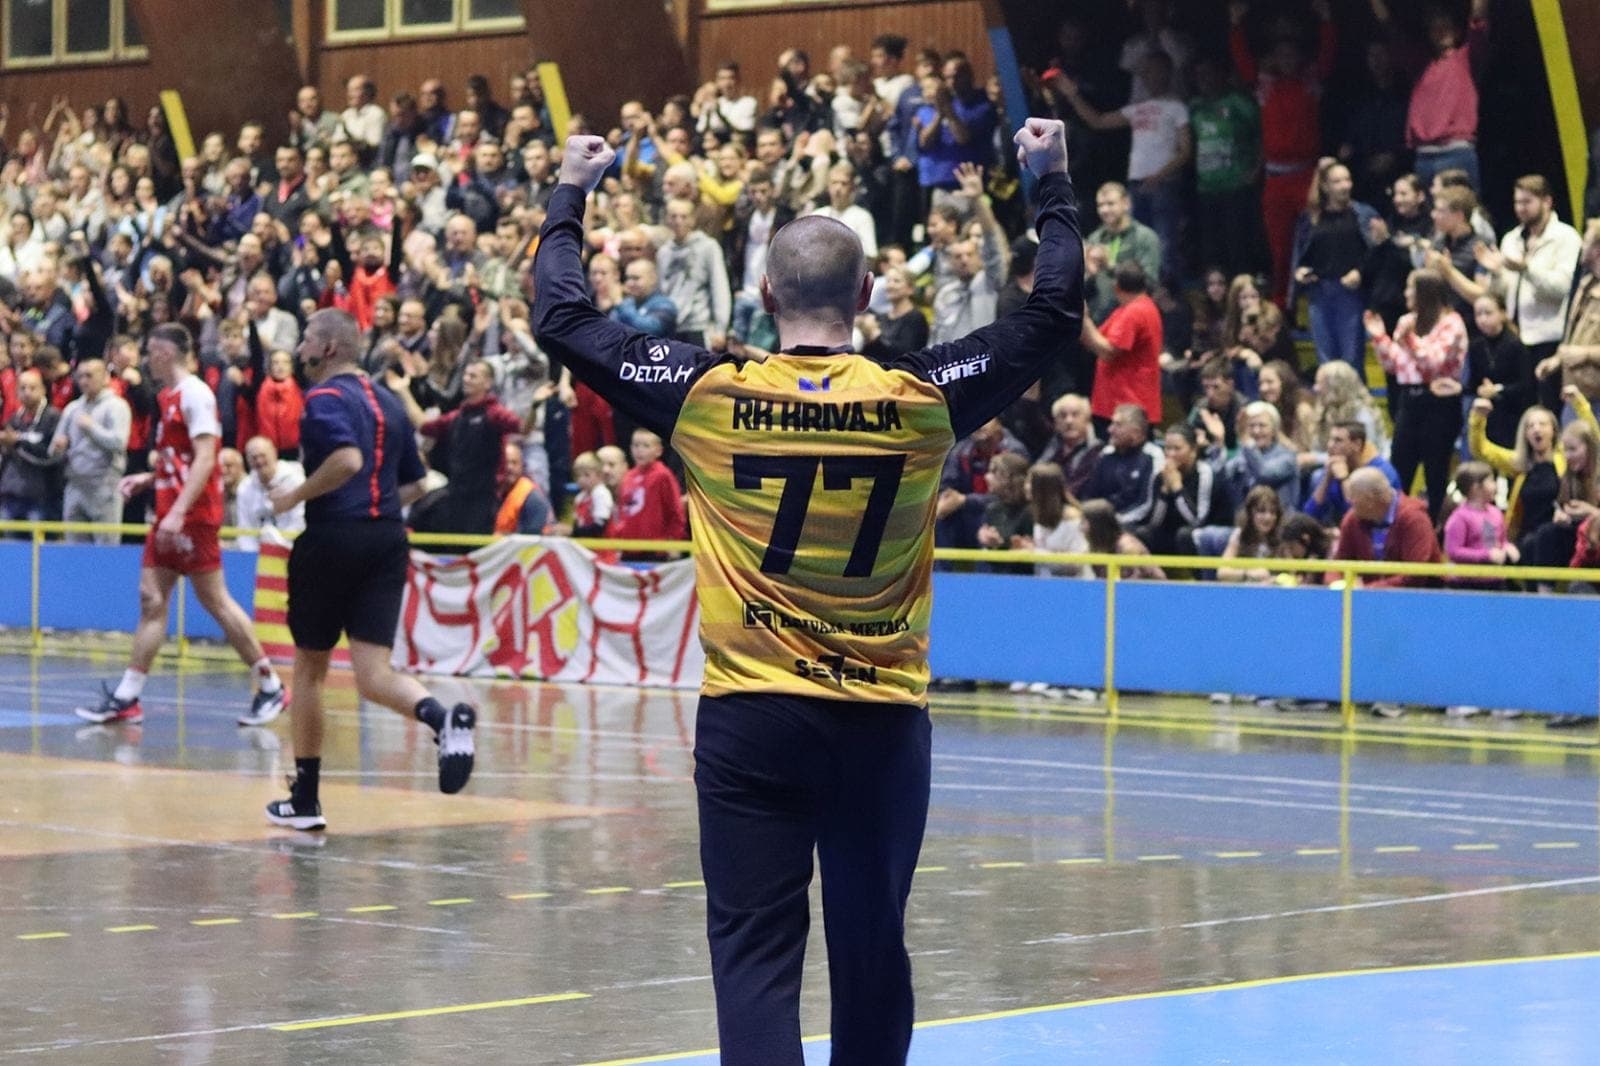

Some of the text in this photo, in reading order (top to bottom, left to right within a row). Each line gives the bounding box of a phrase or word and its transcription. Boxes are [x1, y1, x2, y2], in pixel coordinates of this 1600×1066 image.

[619, 361, 694, 383] DELTAH
[733, 399, 903, 432] RK KRIVAJA
[732, 454, 907, 577] 77
